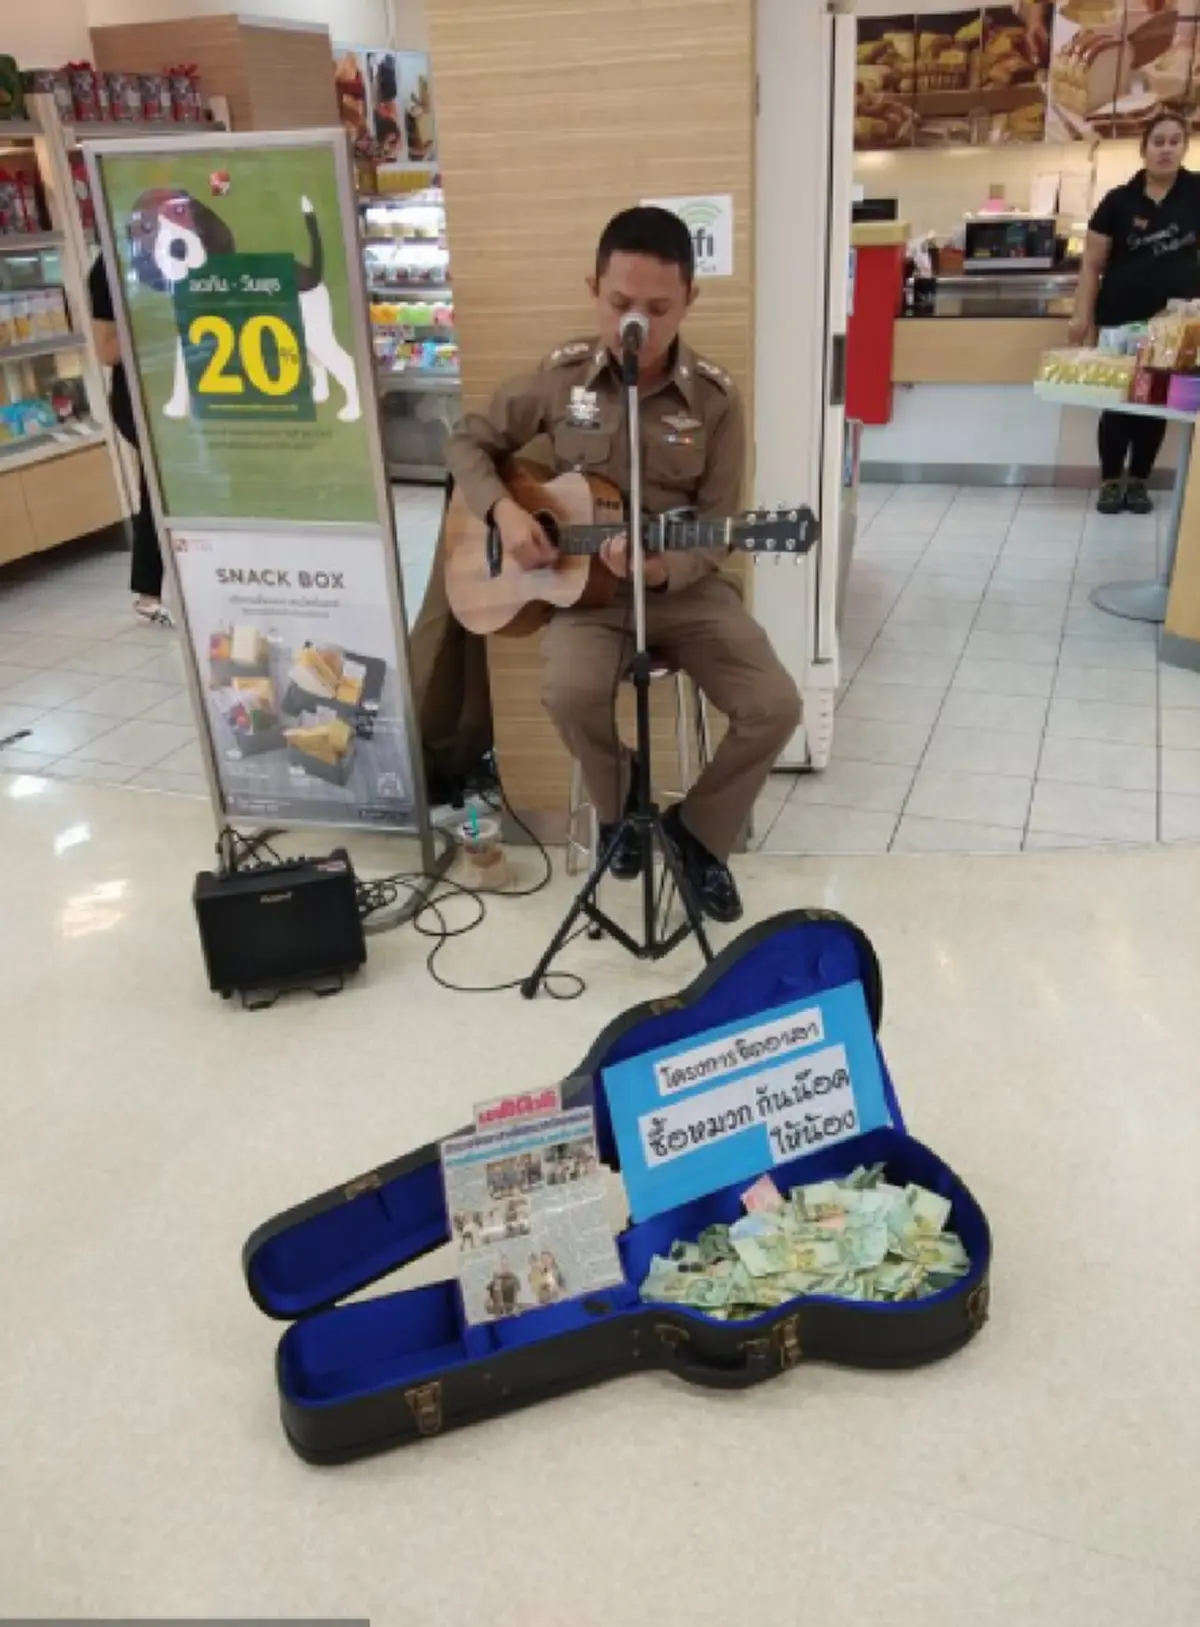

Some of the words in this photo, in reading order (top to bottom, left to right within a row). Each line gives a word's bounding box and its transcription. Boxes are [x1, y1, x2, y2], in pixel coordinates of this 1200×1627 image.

[188, 315, 300, 396] 20
[215, 568, 292, 588] SNACK
[297, 570, 346, 589] BOX
